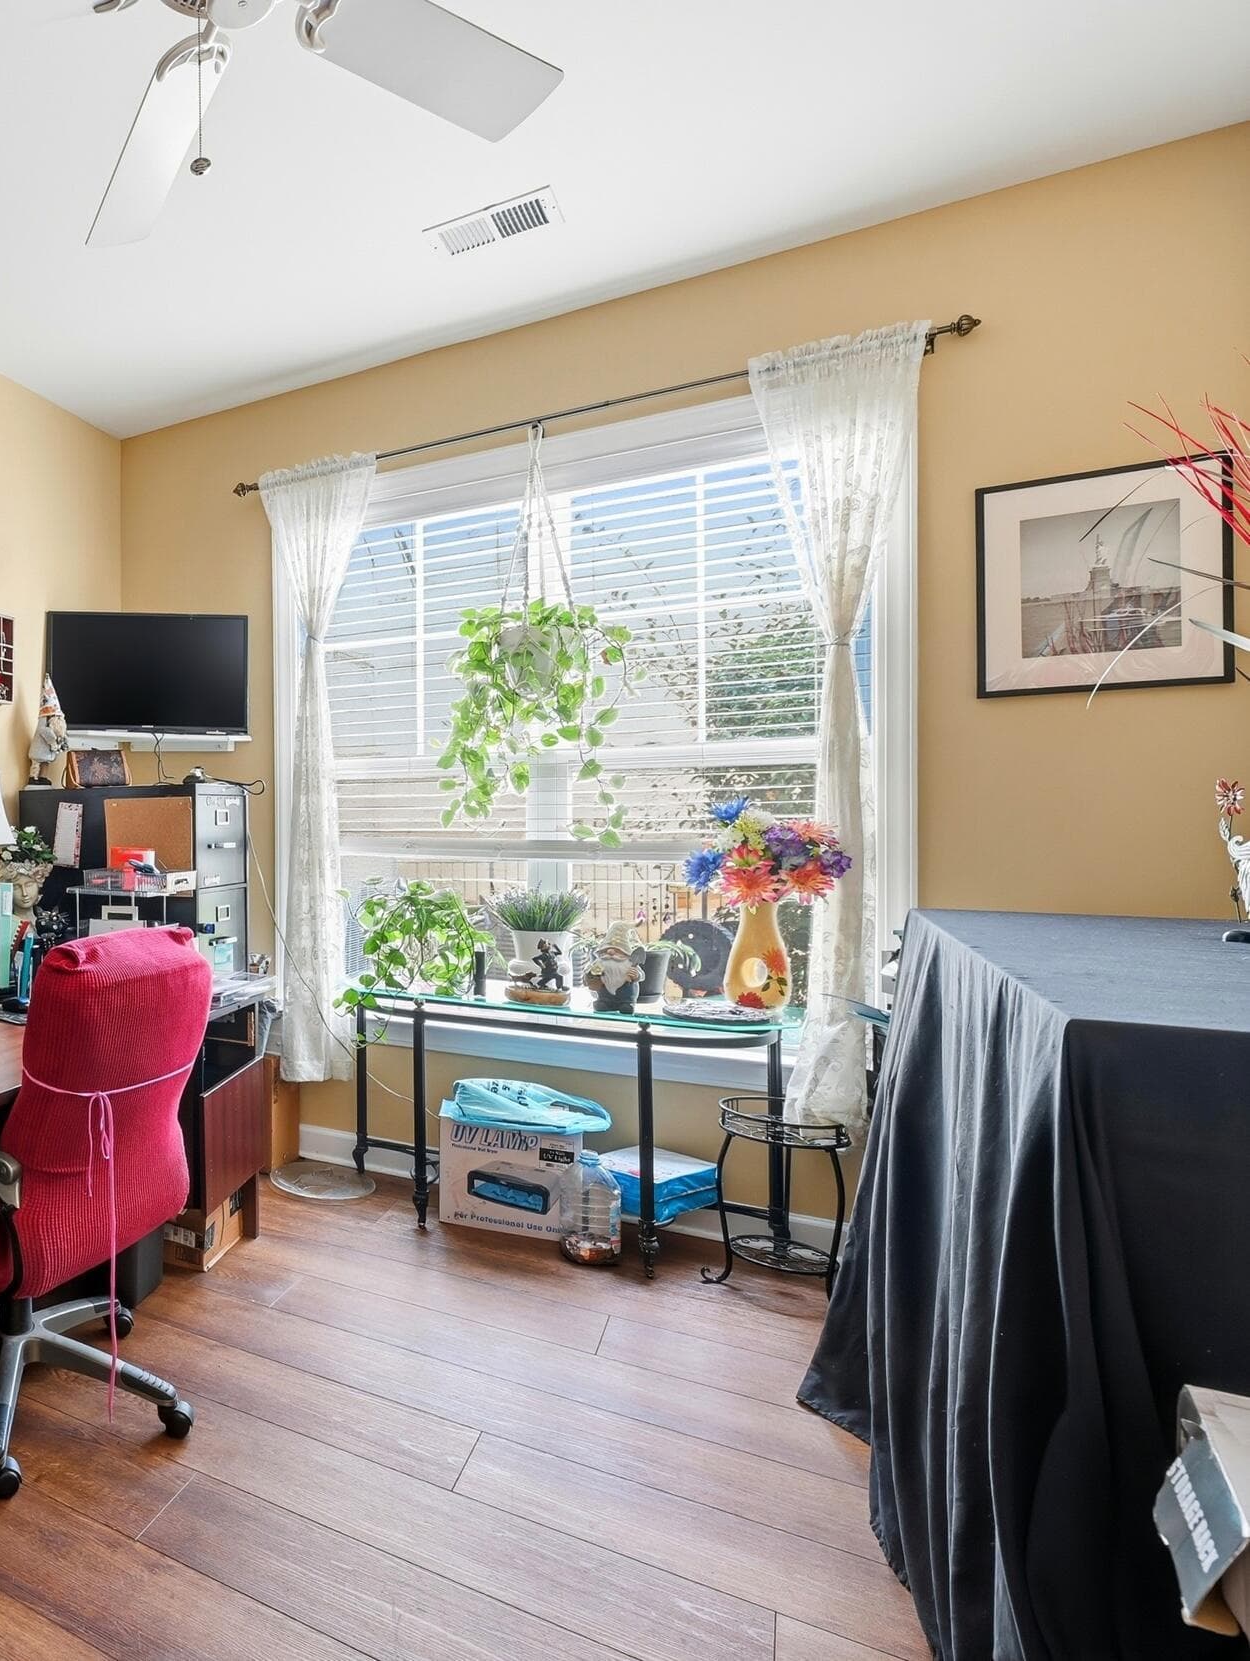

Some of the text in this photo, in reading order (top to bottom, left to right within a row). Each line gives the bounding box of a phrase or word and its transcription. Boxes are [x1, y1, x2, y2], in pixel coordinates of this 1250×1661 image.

[451, 1124, 479, 1145] UV
[454, 1211, 468, 1220] For
[470, 1212, 524, 1229] Professional
[526, 1223, 543, 1232] Use
